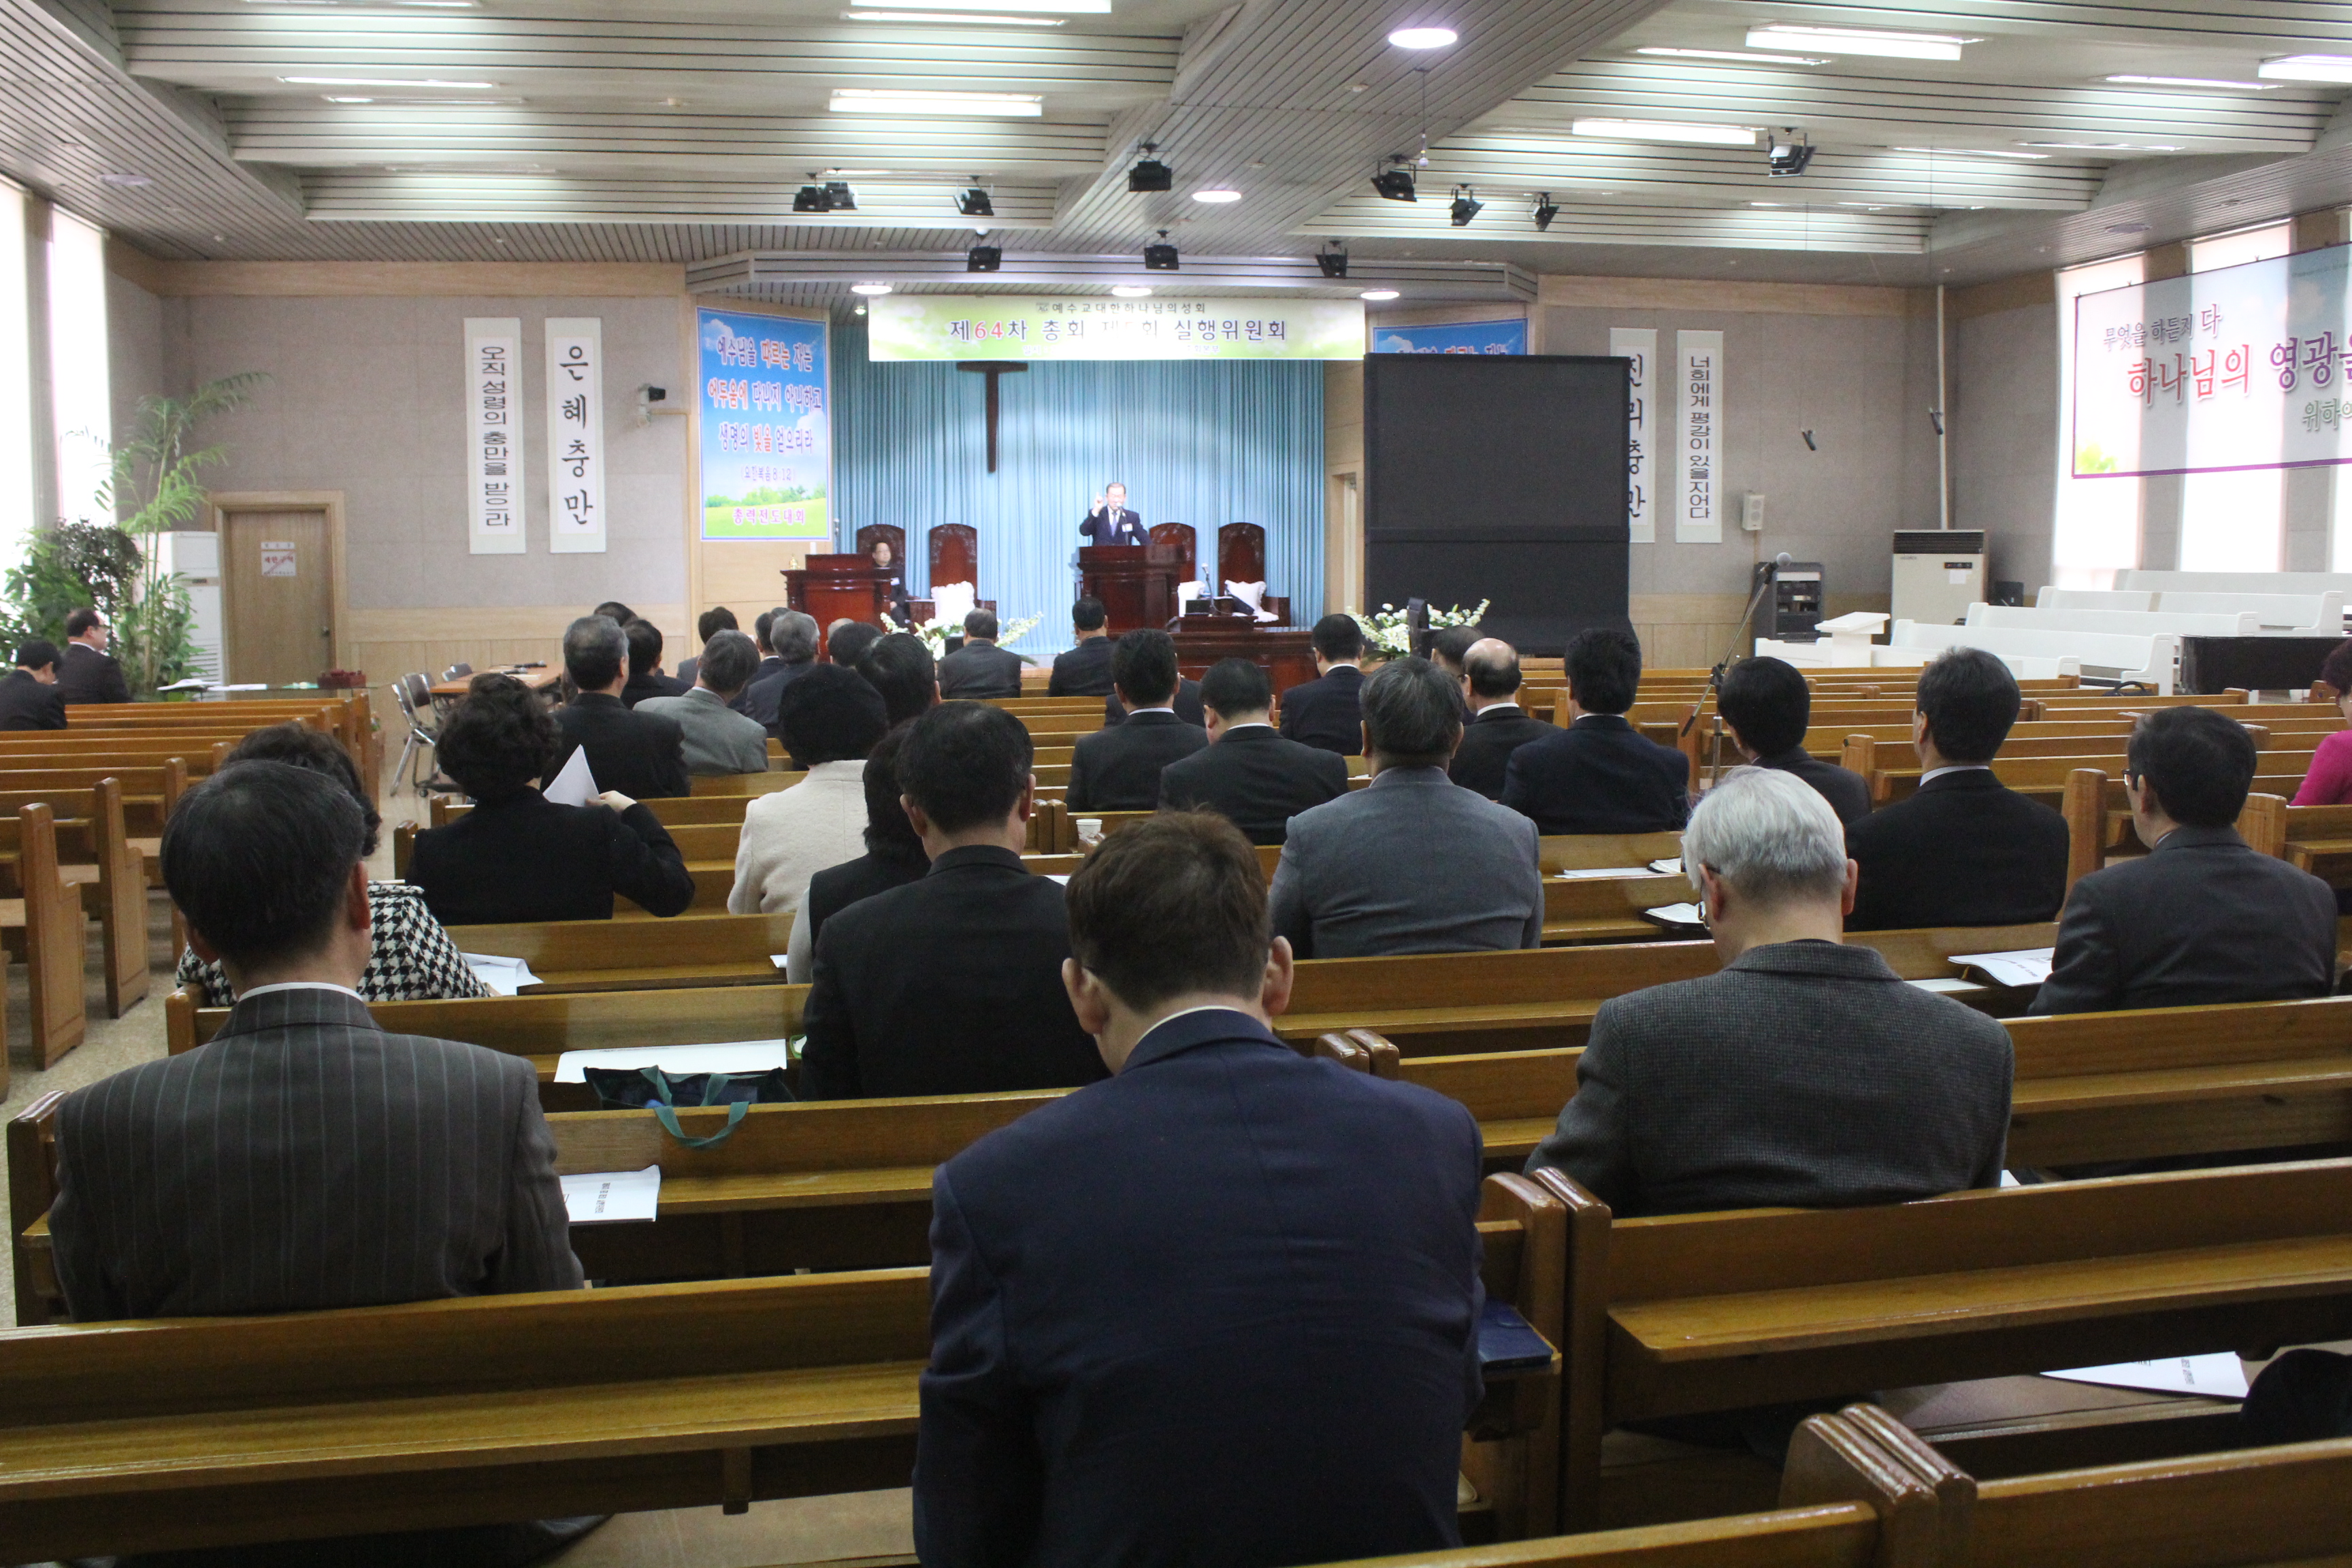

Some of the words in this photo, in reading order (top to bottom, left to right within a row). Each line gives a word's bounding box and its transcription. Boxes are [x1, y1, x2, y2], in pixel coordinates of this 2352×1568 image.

[950, 319, 1027, 340] 제64차
[1042, 319, 1084, 340] 총회
[1175, 319, 1286, 340] 실행위원회
[2103, 321, 2146, 350] 무엇을
[2151, 314, 2193, 344] 하든지
[2201, 304, 2222, 337] 다
[481, 346, 506, 376] 오직
[717, 336, 756, 365] 예수님을
[761, 339, 789, 369] 따르는
[794, 342, 812, 371] 자는
[2127, 344, 2250, 404] 하나님의
[482, 380, 506, 425] 성령의
[752, 381, 781, 412] 다니지
[785, 383, 822, 413] 아니하고
[1690, 356, 1710, 407] 너희에게
[719, 422, 749, 452] 생명의
[753, 423, 772, 453] 빛을
[1690, 412, 1710, 450] 평강이
[483, 431, 508, 476] 충만을
[485, 483, 510, 527] 받으라
[1690, 455, 1710, 519] 있을지어다
